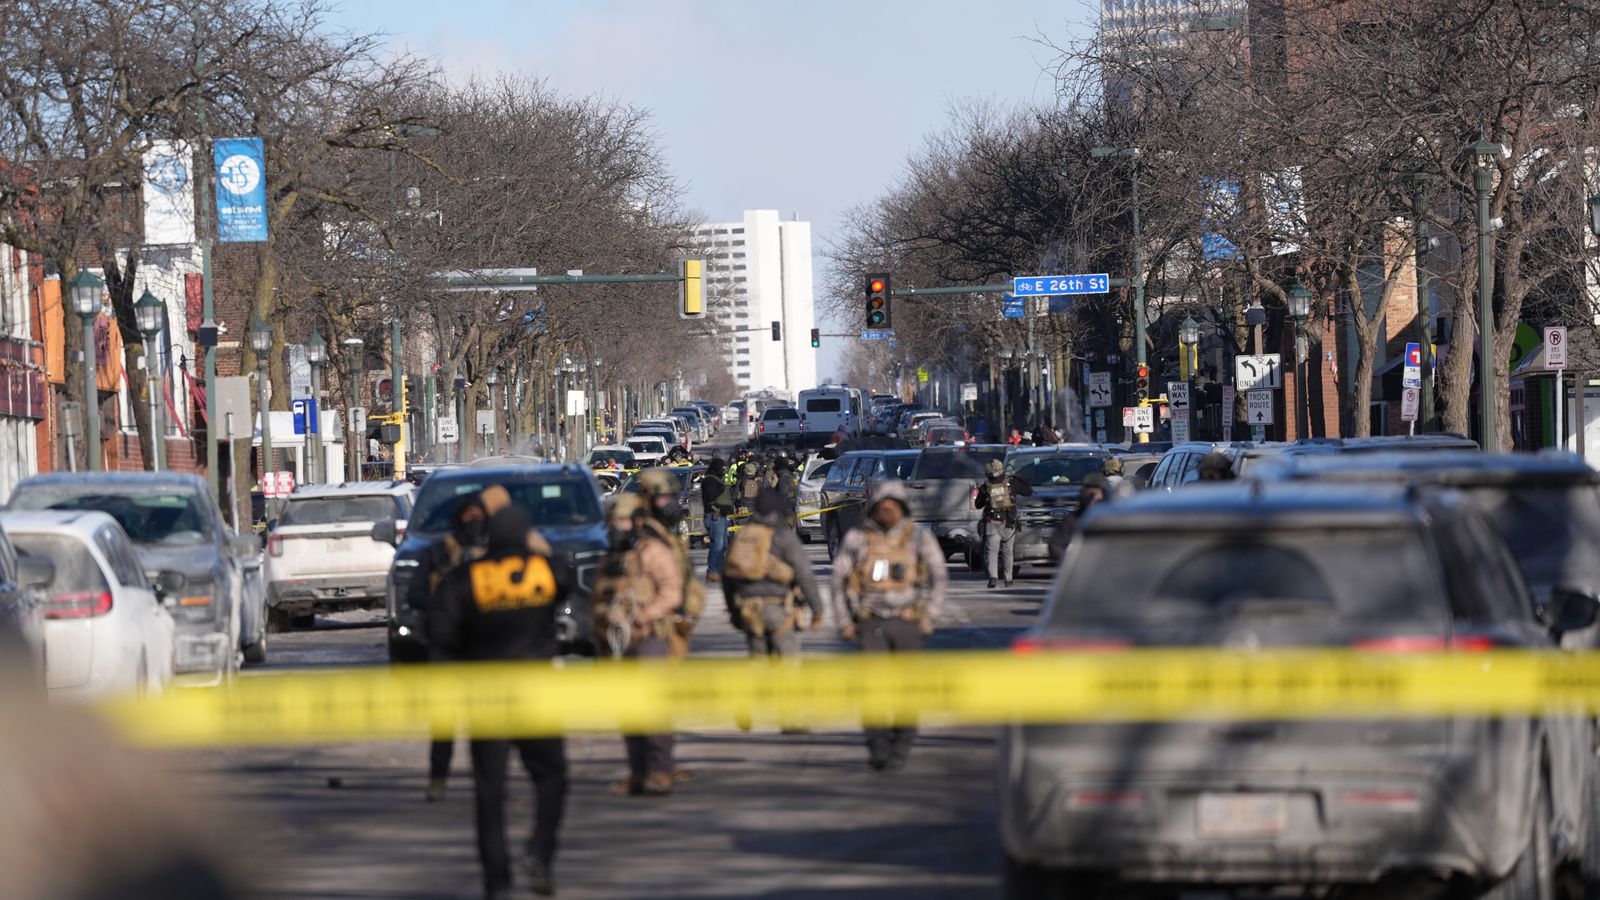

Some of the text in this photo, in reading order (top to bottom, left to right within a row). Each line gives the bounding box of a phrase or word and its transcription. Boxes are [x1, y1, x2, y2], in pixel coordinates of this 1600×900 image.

[1035, 278, 1105, 291] E 26th St
[1249, 393, 1270, 401] TRUCK
[1249, 401, 1270, 409] ROUTE
[469, 555, 557, 606] BCA
